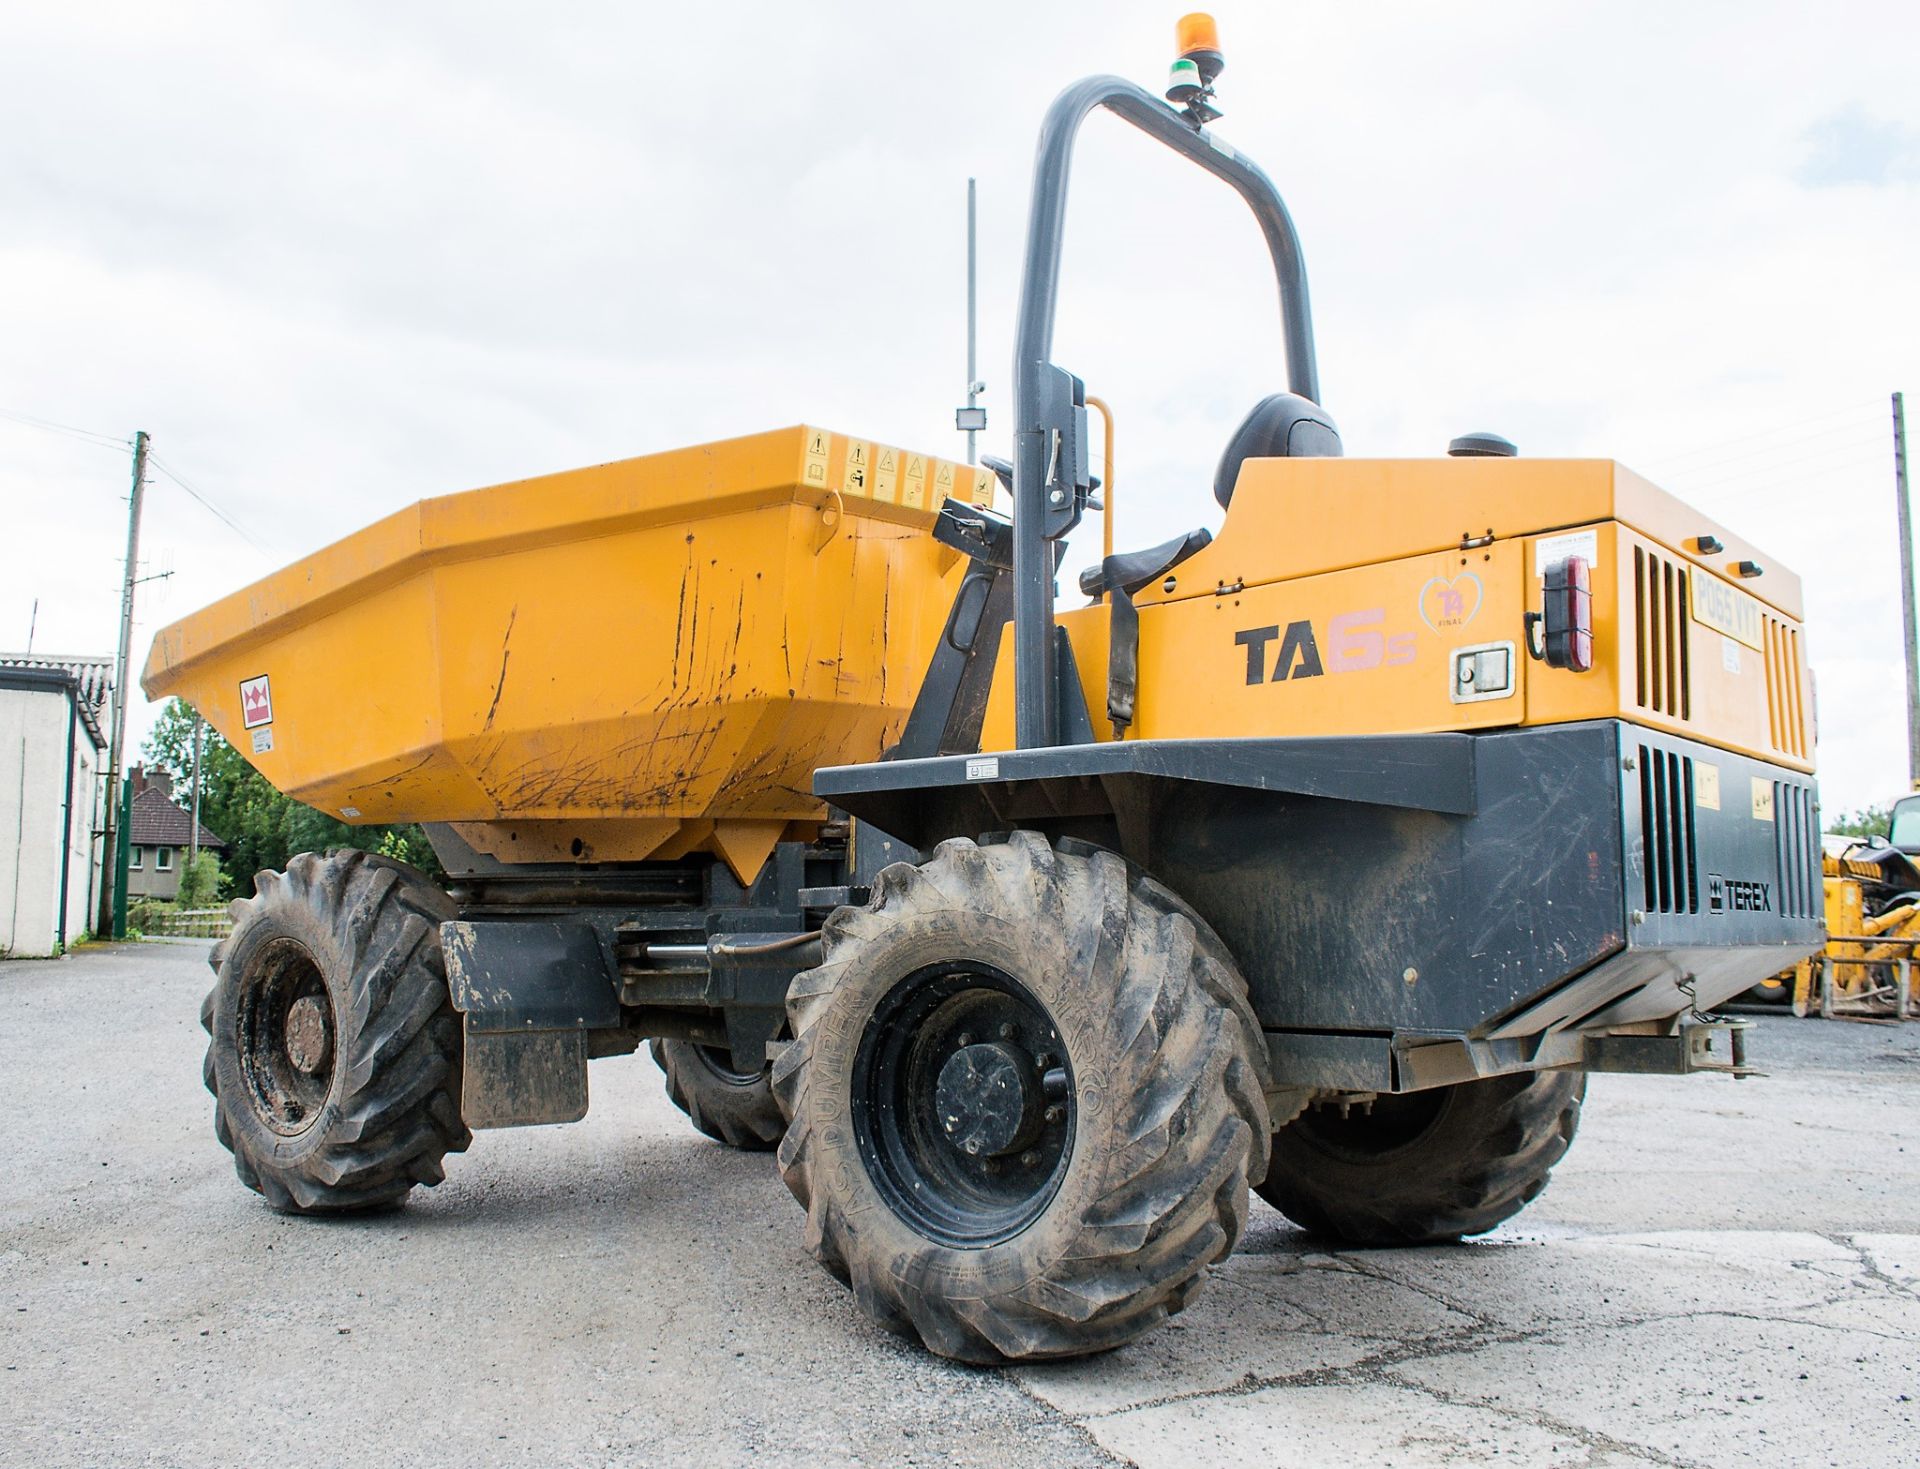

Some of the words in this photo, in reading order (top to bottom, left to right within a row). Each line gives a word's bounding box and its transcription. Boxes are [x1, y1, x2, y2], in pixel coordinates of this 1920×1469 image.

[1735, 594, 1758, 641] VYT
[1725, 880, 1771, 911] TEREX
[815, 987, 866, 1150] DUMPER
